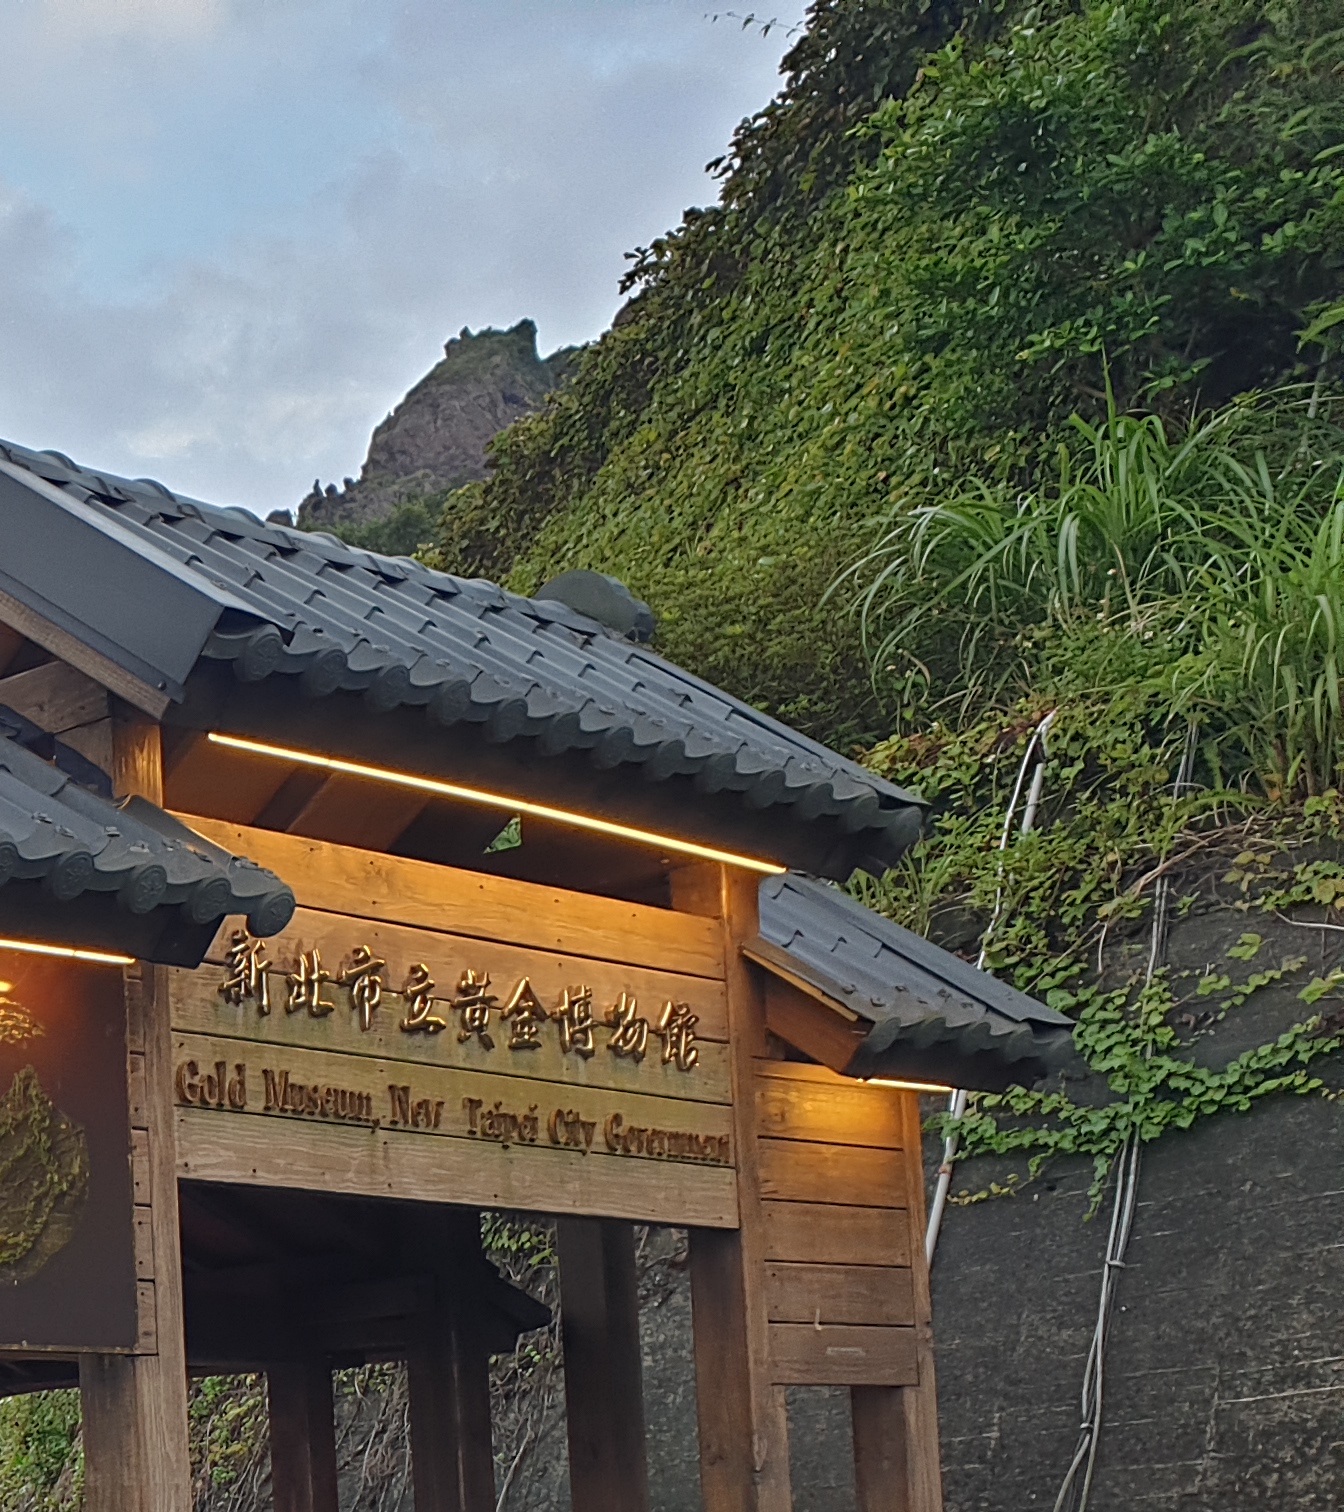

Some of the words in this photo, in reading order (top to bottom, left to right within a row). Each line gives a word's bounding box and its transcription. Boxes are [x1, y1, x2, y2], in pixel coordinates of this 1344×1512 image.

[175, 1060, 247, 1110] Gold
[387, 1084, 445, 1129] New
[463, 1096, 539, 1151] Taipei
[547, 1108, 597, 1157] City
